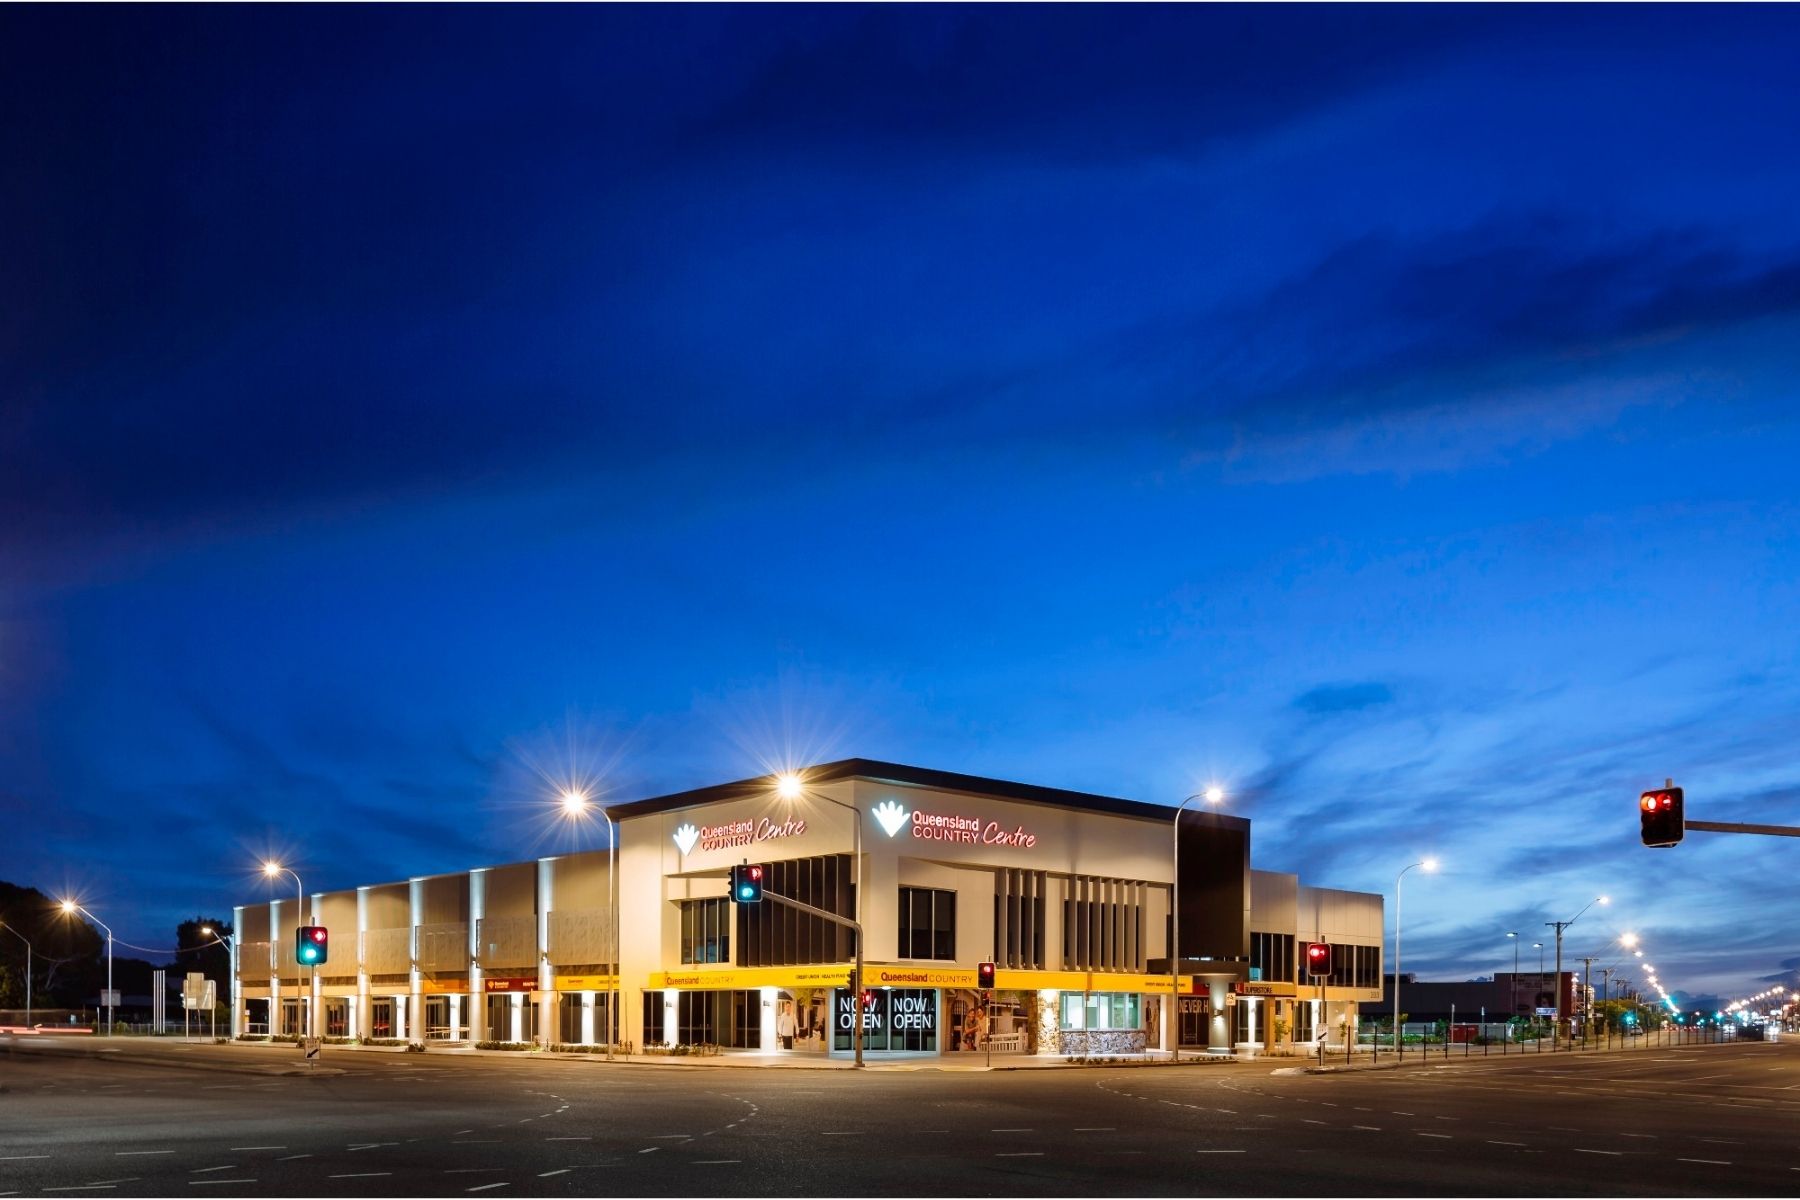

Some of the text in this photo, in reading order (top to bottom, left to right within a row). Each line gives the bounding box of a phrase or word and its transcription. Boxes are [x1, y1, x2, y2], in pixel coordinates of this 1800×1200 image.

[912, 810, 979, 831] Queensland
[701, 819, 753, 840] Queensland
[701, 815, 805, 851] COUNTRY Centre
[912, 821, 1036, 848] COUNTRY Centre
[666, 976, 700, 986] Queensland
[881, 972, 973, 983] Queensland COUNTRY
[893, 997, 927, 1012] NOW
[1179, 1000, 1203, 1013] NEVER
[893, 1014, 932, 1029] OPEN
